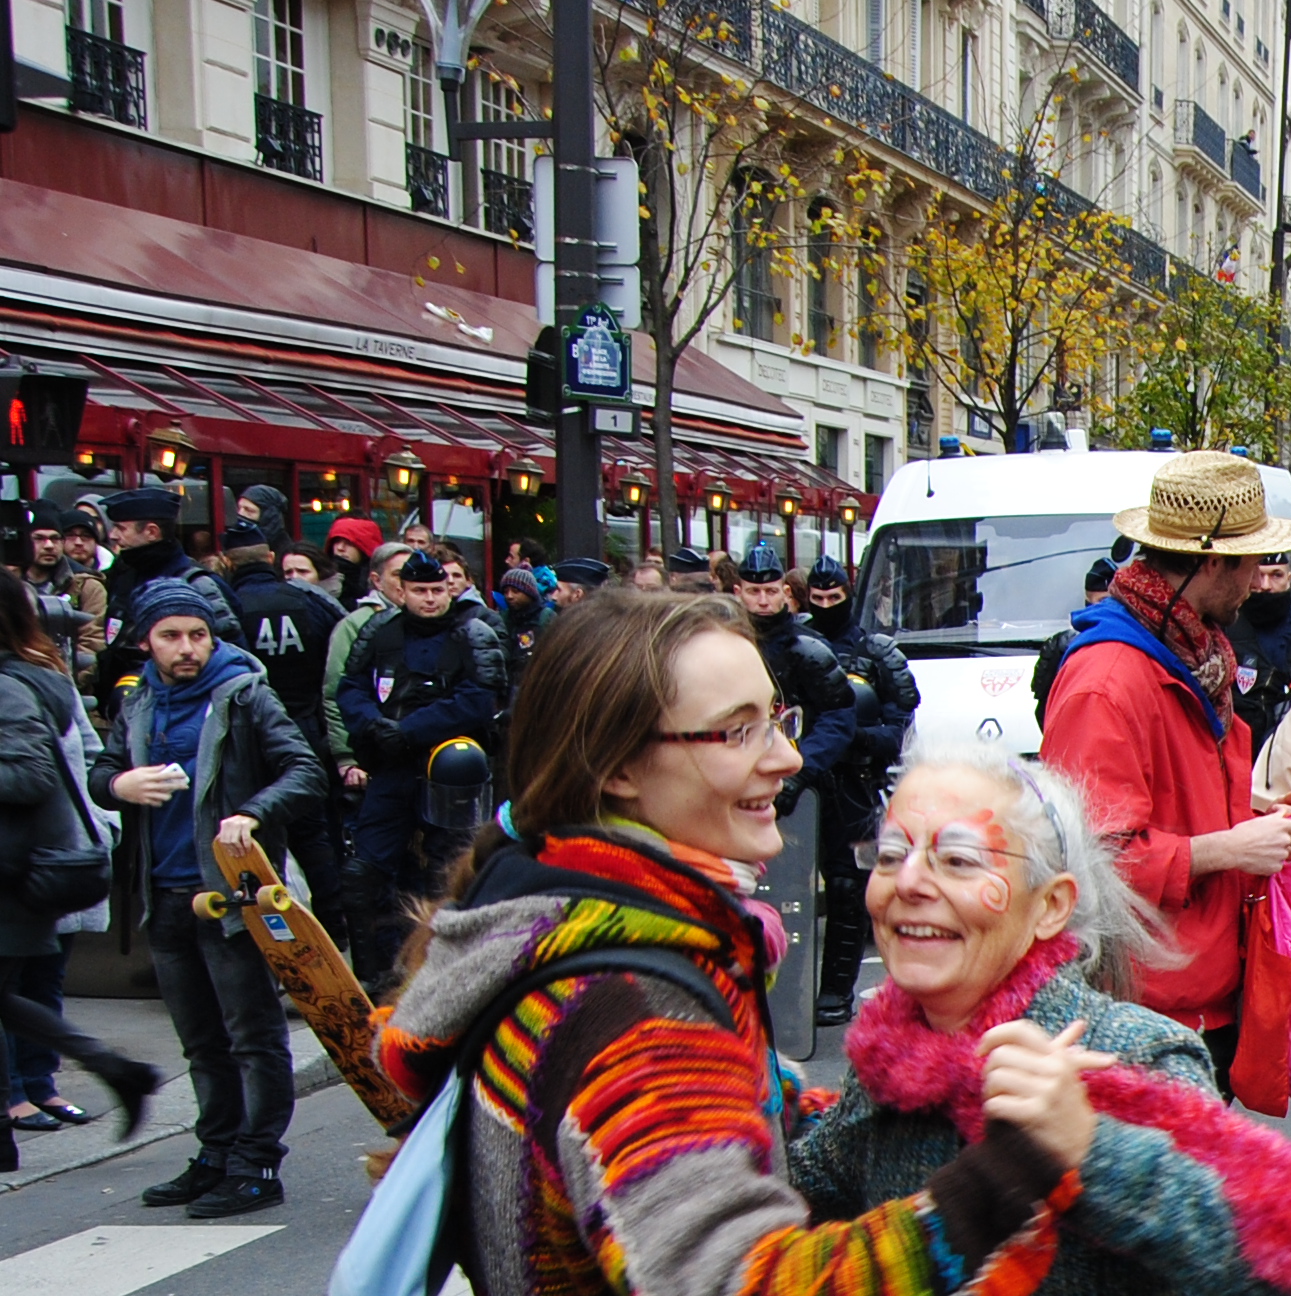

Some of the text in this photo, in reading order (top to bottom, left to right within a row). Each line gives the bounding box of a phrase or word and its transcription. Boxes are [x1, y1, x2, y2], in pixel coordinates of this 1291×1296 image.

[356, 337, 415, 359] LA TAVERNE
[610, 414, 618, 427] 1
[256, 615, 305, 656] 4A
